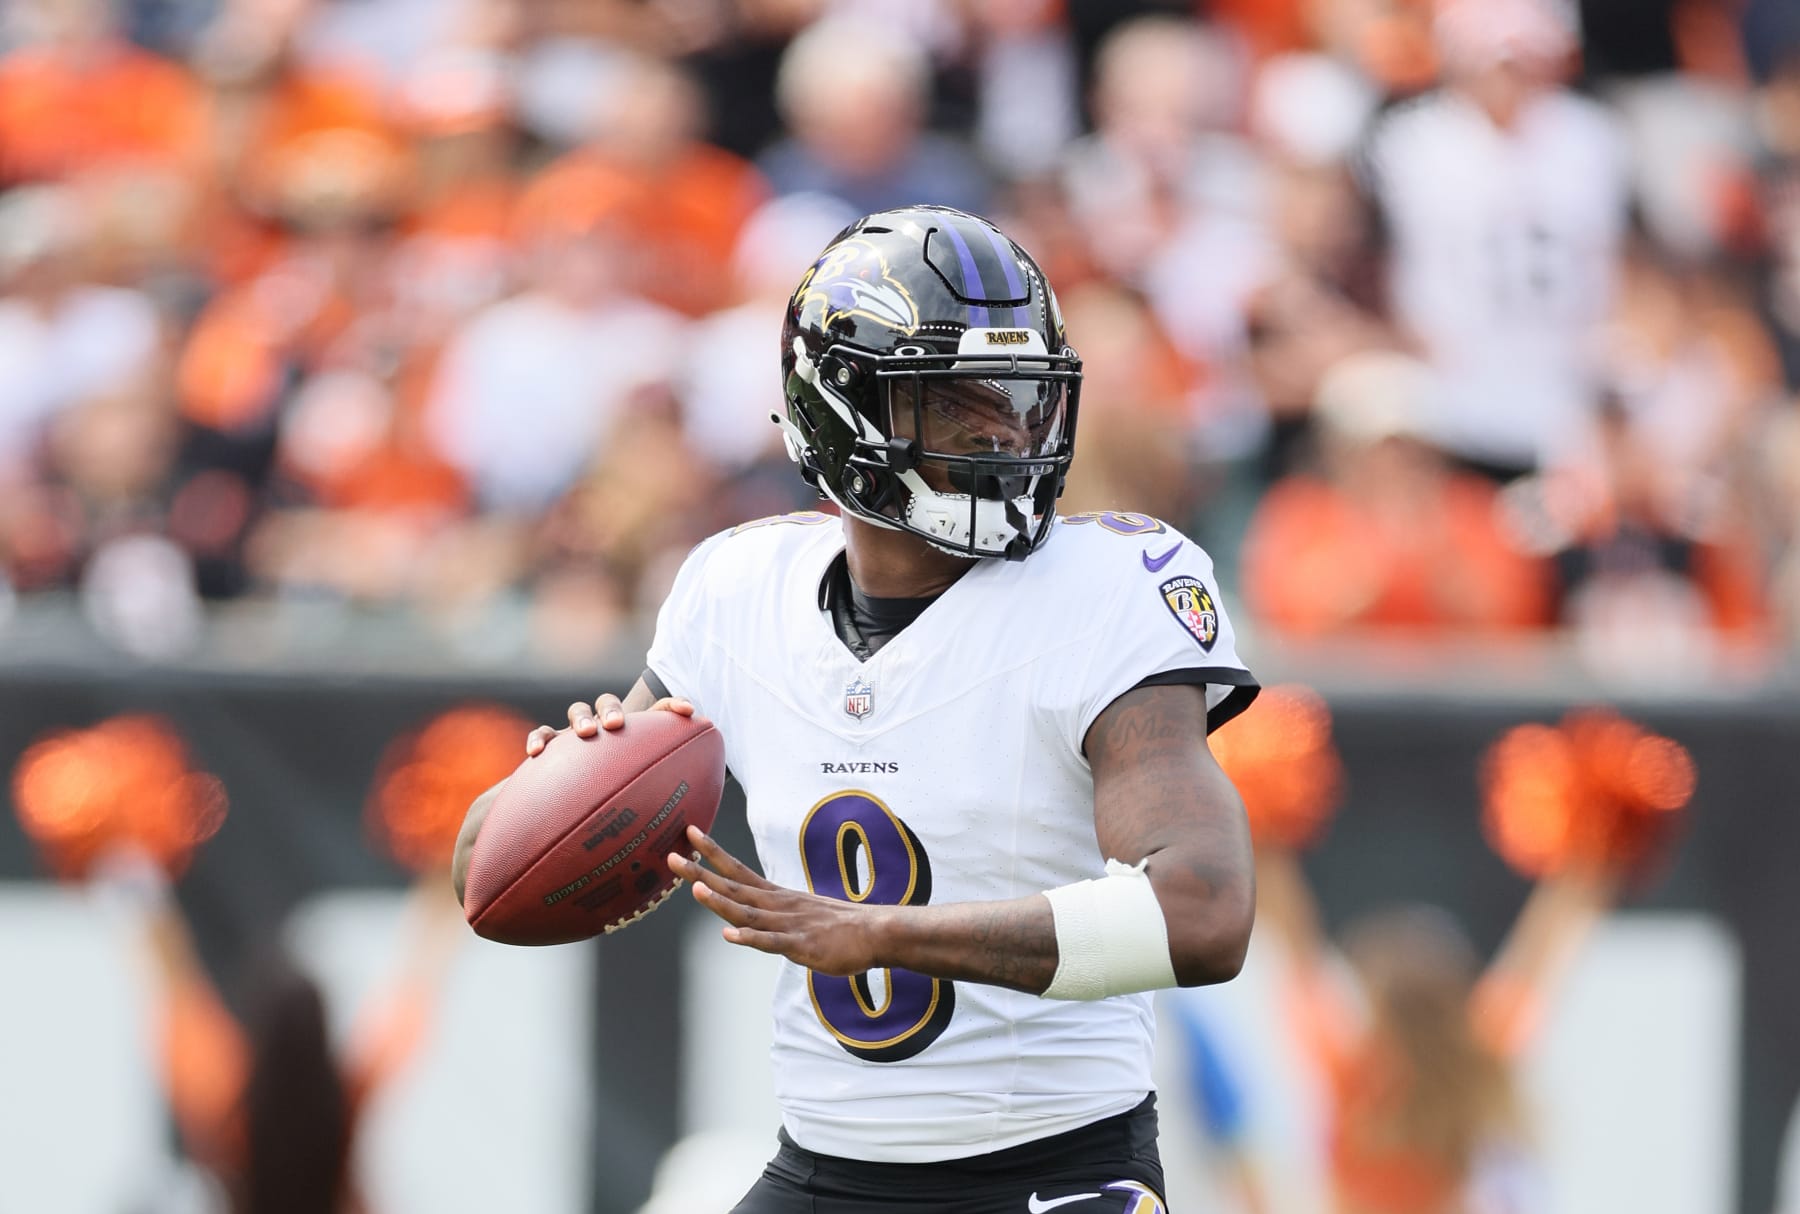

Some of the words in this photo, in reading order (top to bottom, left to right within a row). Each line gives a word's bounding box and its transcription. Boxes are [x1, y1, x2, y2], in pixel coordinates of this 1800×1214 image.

[984, 331, 1030, 346] RAVENS
[1161, 578, 1203, 593] RAVENS
[1174, 589, 1193, 612] B
[847, 697, 869, 714] NFL
[820, 762, 899, 774] RAVENS
[647, 780, 690, 831] NATIONAL
[591, 829, 648, 878] FOOTBALL
[544, 875, 592, 906] LEAGUE
[799, 788, 956, 1063] 8
